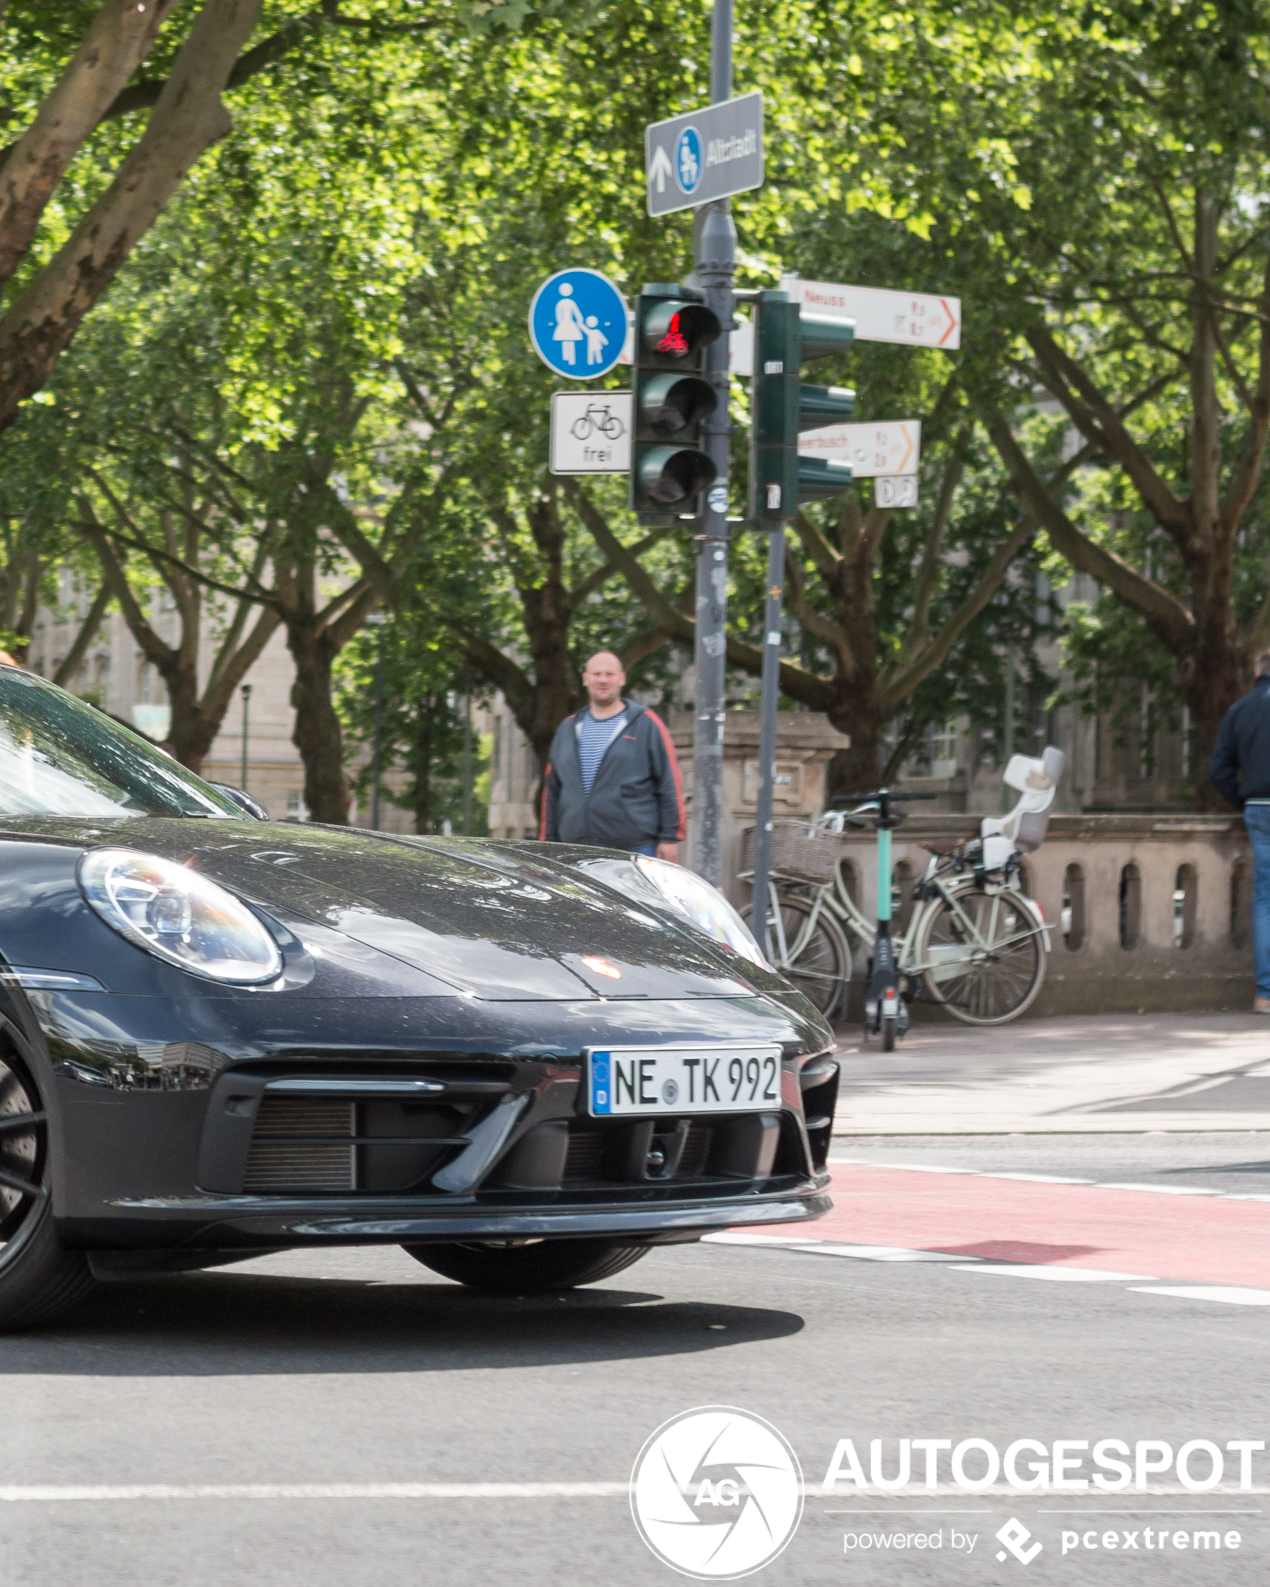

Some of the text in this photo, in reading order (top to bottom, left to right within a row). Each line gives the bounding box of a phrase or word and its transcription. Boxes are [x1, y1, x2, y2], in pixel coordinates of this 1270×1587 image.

[706, 129, 756, 167] Altstadt
[804, 289, 845, 308] Neuss
[798, 433, 848, 449] eerbusch
[583, 446, 612, 463] frei
[615, 1056, 776, 1105] NE TK 992
[596, 1090, 607, 1105] D
